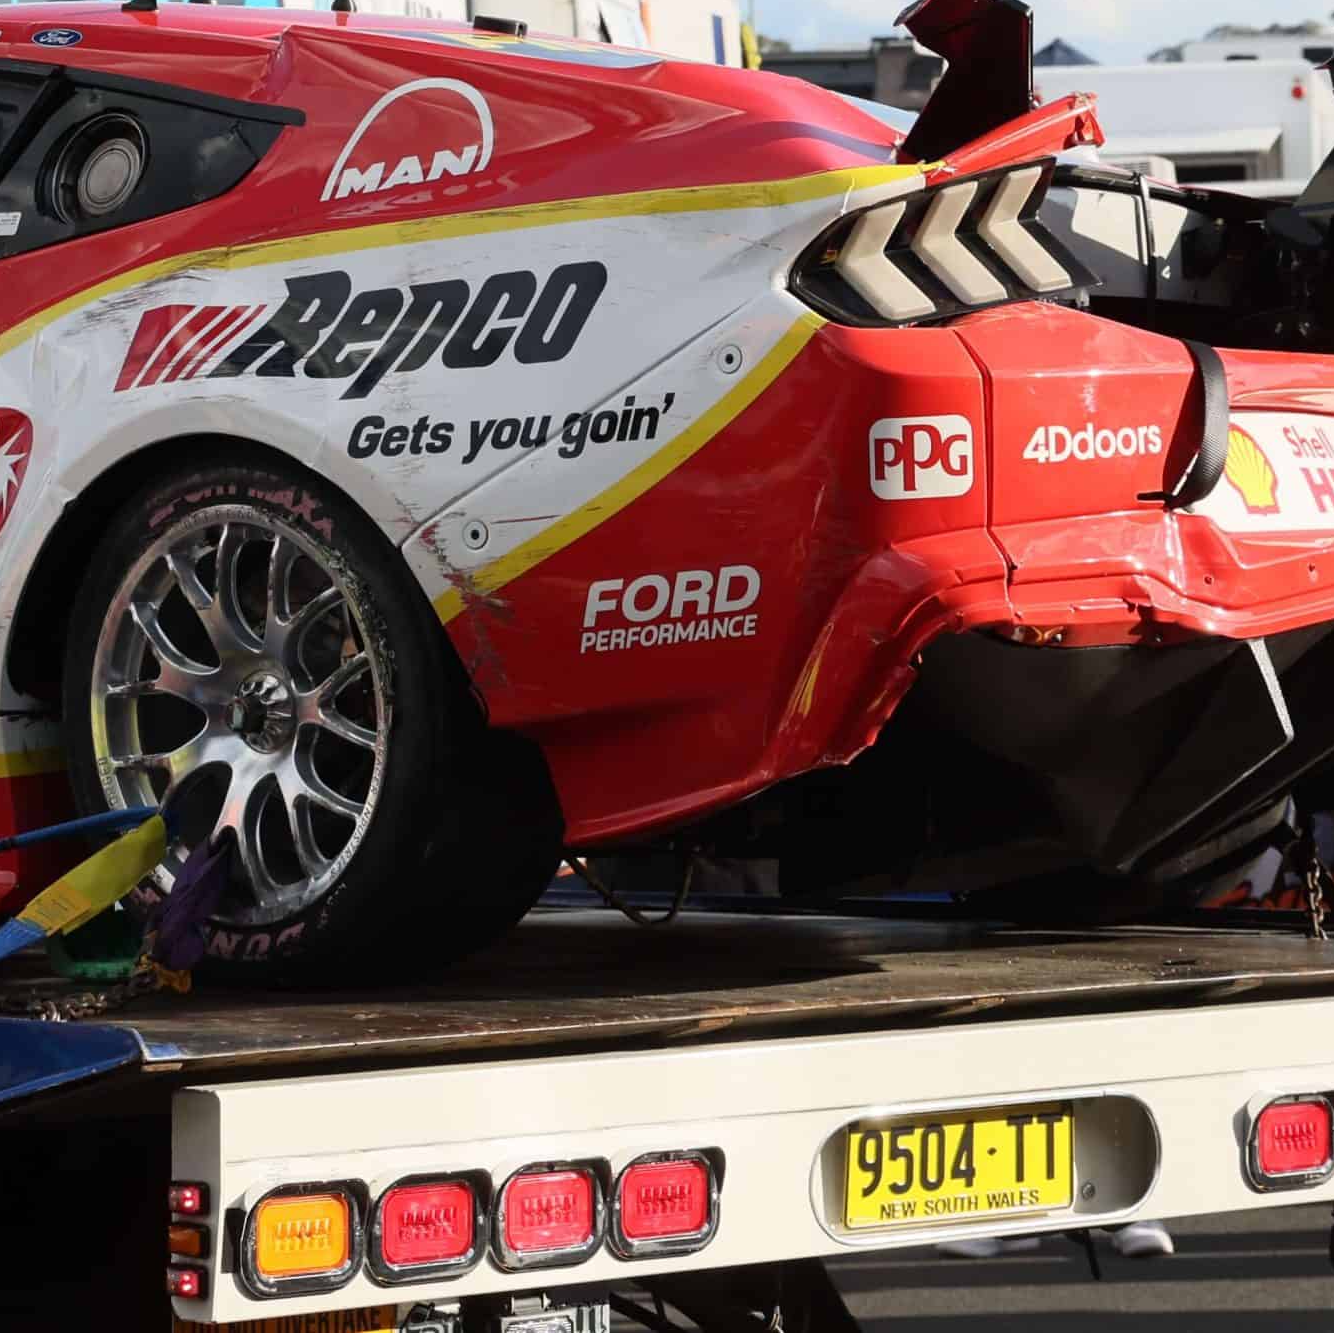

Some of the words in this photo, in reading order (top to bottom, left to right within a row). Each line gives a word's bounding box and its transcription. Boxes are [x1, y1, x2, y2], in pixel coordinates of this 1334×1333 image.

[334, 146, 481, 198] MAN
[208, 261, 609, 400] Repco
[347, 414, 454, 460] Gets
[461, 415, 549, 464] you
[874, 424, 968, 492] PPG
[1022, 422, 1163, 464] 4Ddoors
[582, 565, 762, 629] FORD
[579, 613, 759, 655] PERFORMANCE
[857, 1119, 977, 1198] 9504
[879, 1201, 918, 1221] NEW
[923, 1195, 980, 1216] SOUTH
[986, 1188, 1041, 1211] WALES
